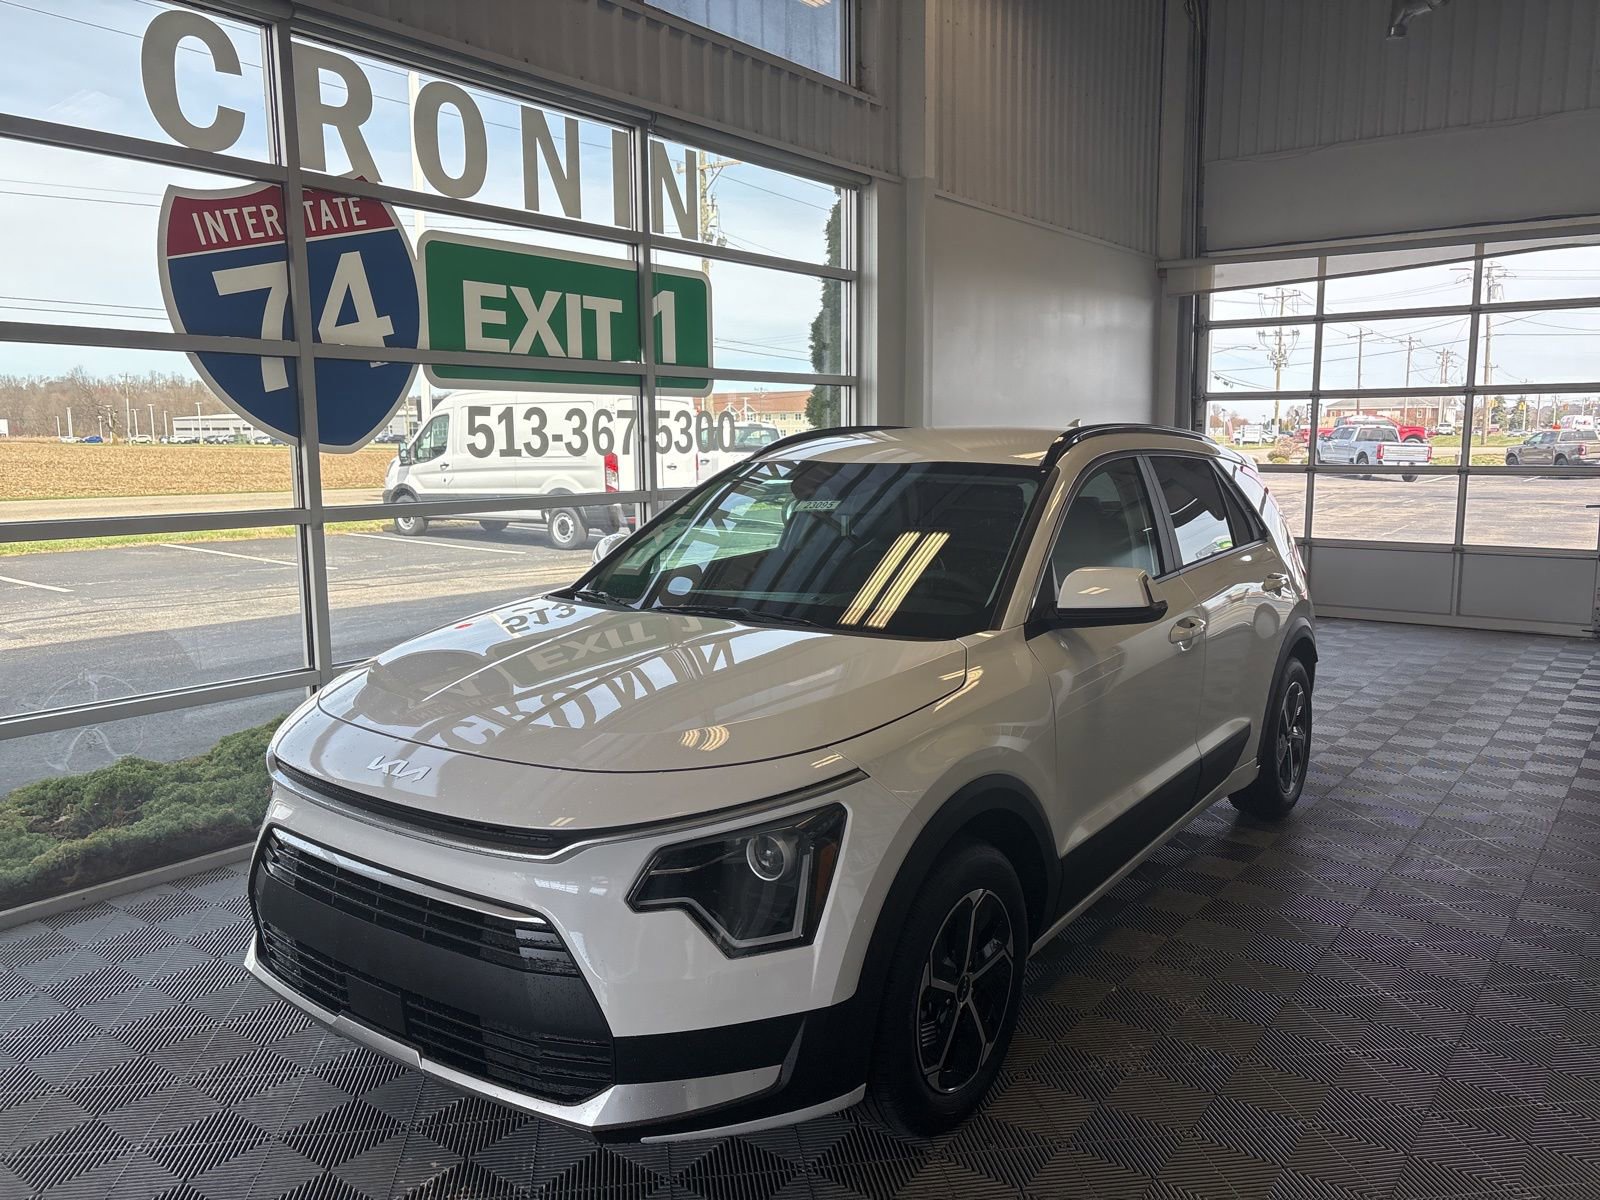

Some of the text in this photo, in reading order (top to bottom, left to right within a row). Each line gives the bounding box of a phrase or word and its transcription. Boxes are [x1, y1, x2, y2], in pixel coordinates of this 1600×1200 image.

[141, 9, 698, 240] CRONIN
[192, 196, 367, 246] INTERTATE
[212, 251, 394, 393] 74
[462, 279, 677, 364] EXIT 1
[466, 405, 736, 459] 513-3675300
[803, 500, 834, 509] 23095
[366, 755, 432, 783] KIA
